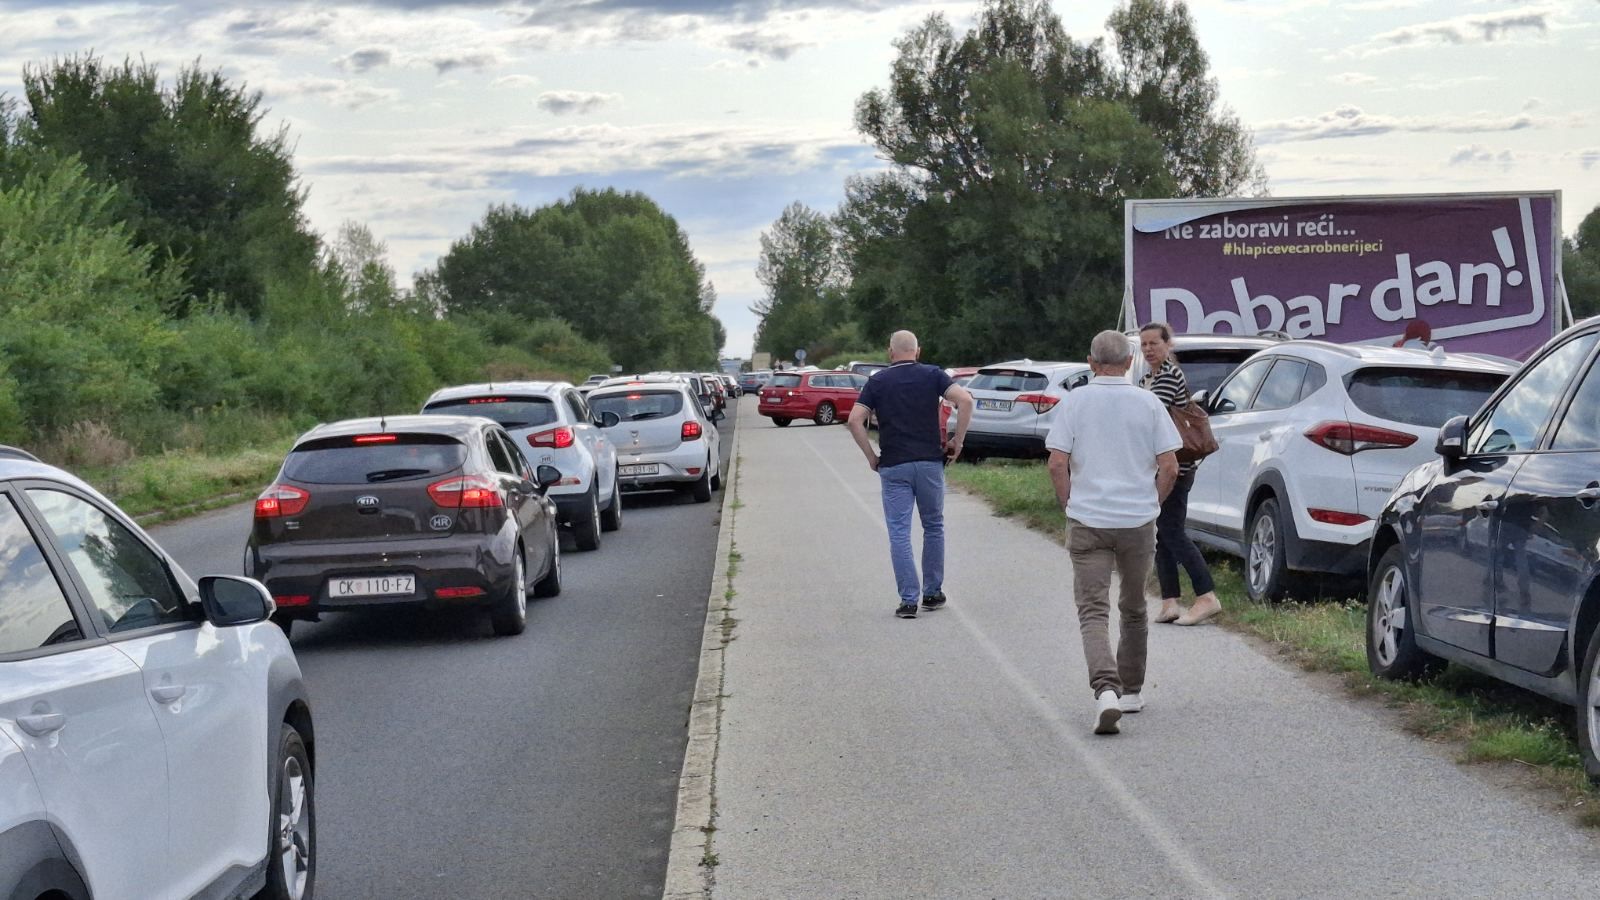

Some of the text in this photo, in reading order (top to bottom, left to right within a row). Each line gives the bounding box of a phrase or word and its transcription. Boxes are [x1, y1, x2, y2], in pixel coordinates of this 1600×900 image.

[1165, 214, 1356, 240] Ne zaboravi reći...
[1222, 239, 1384, 259] #hlapicevecarobnerijeci
[1370, 226, 1523, 322] dan!
[358, 497, 377, 506] KIA
[433, 518, 448, 527] HR
[339, 581, 354, 594] CK
